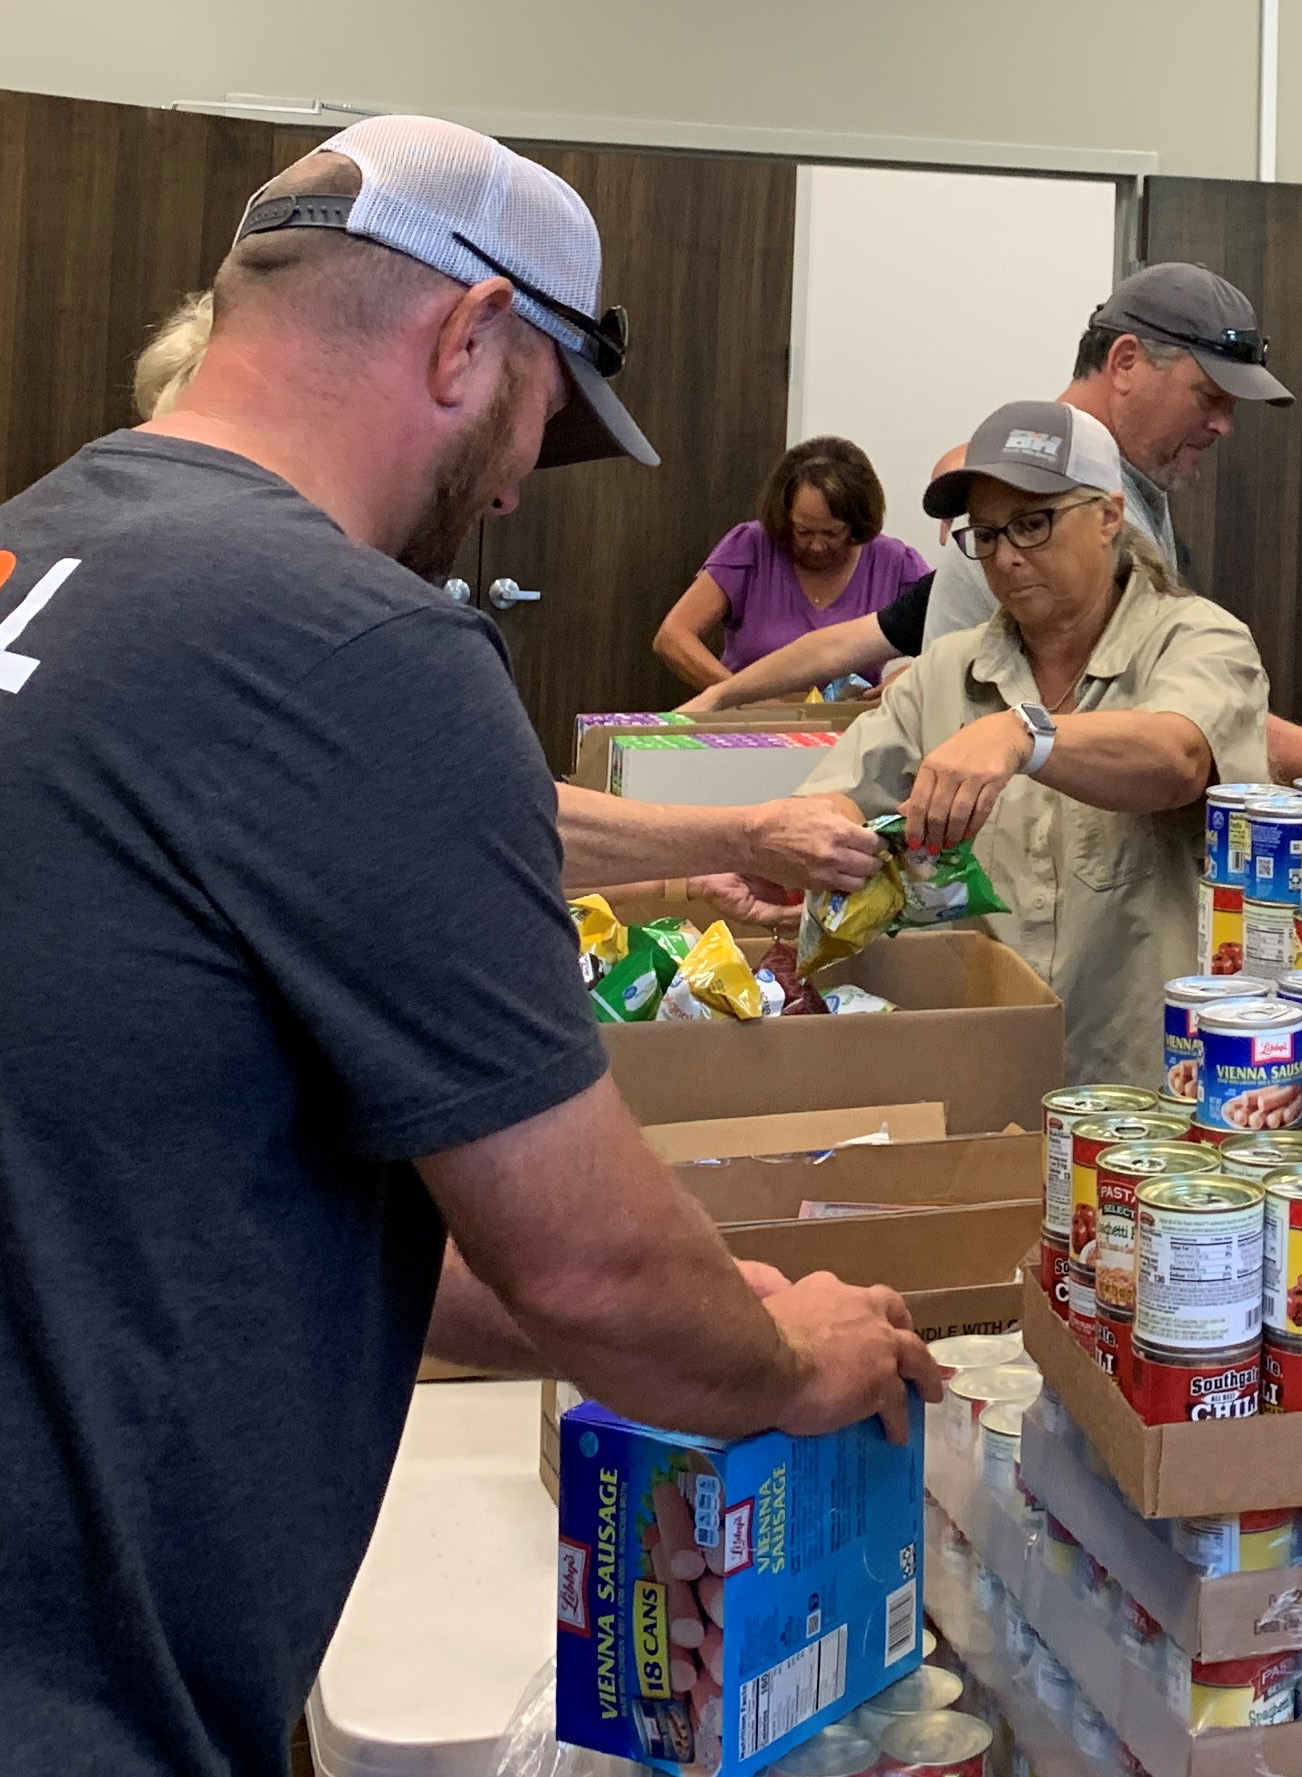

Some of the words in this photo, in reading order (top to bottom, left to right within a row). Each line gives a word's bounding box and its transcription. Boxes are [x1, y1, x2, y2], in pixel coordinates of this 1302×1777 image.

[1216, 1065, 1268, 1080] VIENNA
[963, 1320, 1003, 1336] WITH
[597, 1467, 619, 1604] SAUSAGE
[730, 1515, 744, 1559] Libby's
[757, 1476, 773, 1575] VIENNA
[771, 1461, 787, 1575] SAUSAGE
[561, 1553, 578, 1618] Libby's
[643, 1587, 659, 1656] CANS
[596, 1613, 618, 1720] VIENNA
[643, 1660, 665, 1692] 18
